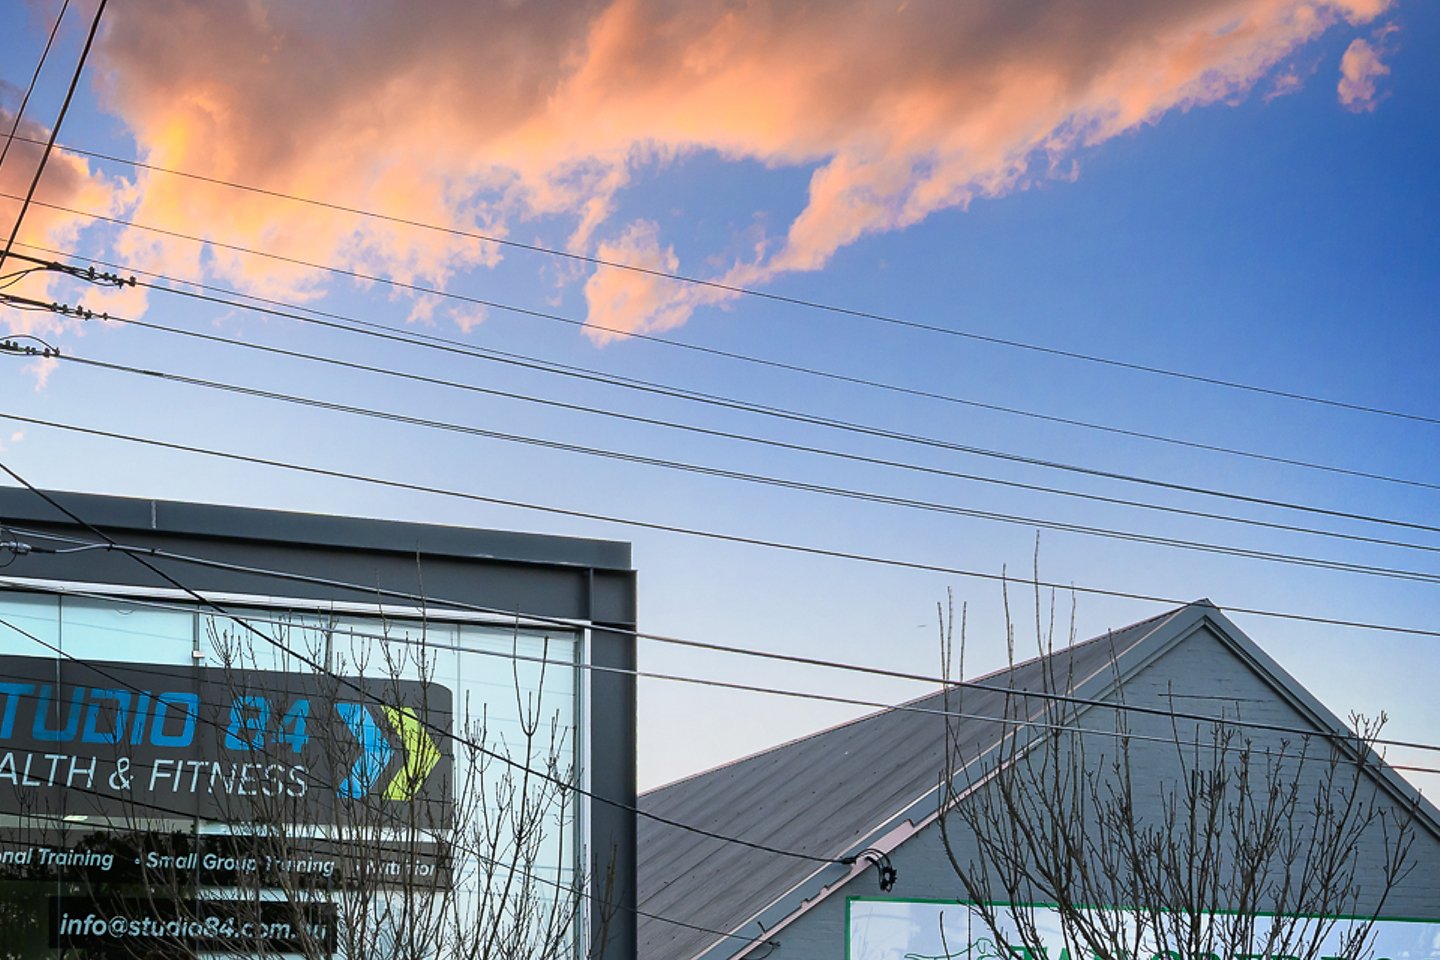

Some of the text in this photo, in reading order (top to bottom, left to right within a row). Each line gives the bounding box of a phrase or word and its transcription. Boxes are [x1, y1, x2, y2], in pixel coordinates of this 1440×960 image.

[224, 695, 311, 753] 84
[108, 756, 135, 791] &
[147, 758, 310, 798] FITNESS
[37, 847, 115, 872] Training
[145, 851, 198, 870] Small
[265, 854, 336, 878] Taining
